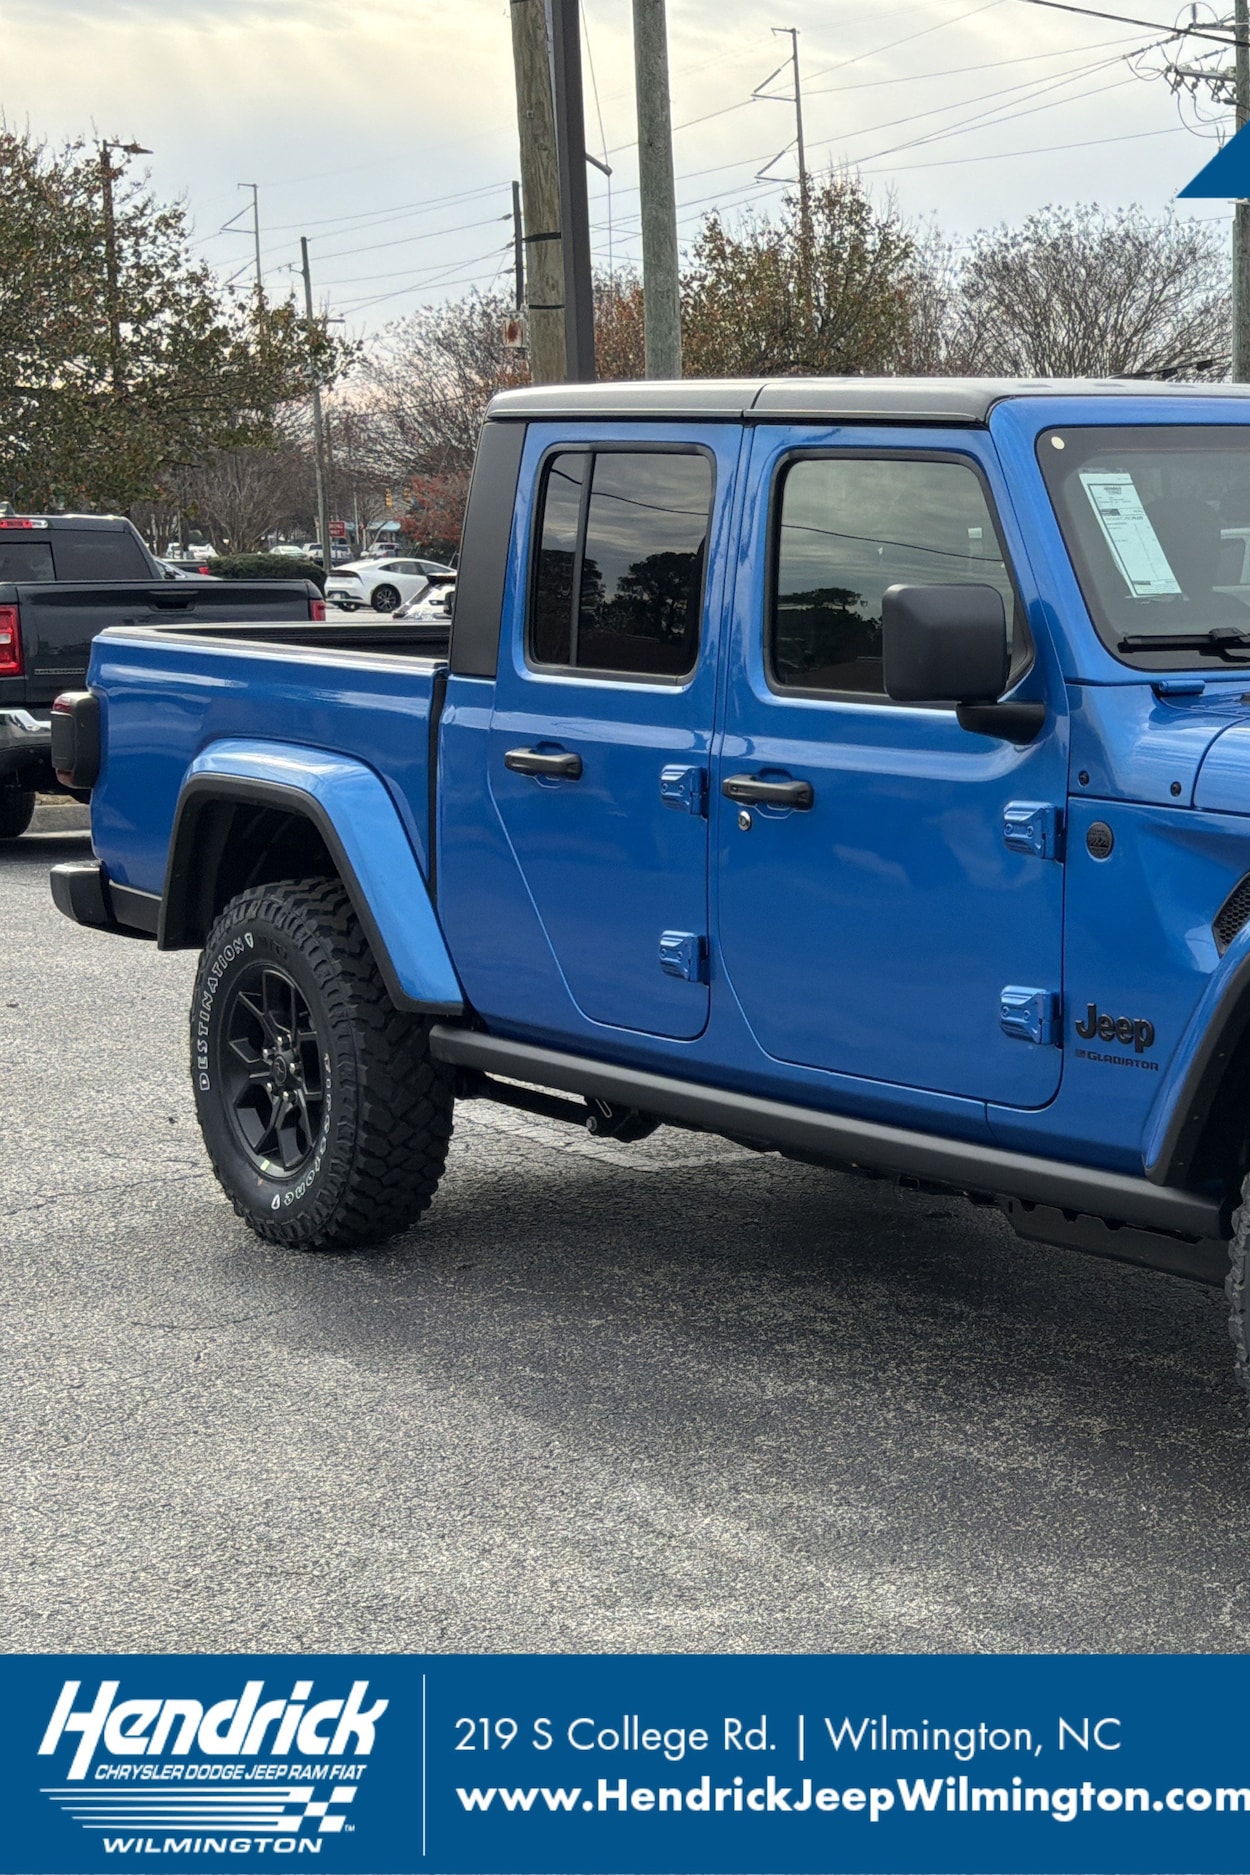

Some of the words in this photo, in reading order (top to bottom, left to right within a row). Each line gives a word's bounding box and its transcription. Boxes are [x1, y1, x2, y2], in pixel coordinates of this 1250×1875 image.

[200, 936, 246, 1092] DESTINATION
[1075, 1002, 1155, 1054] Jeep
[1087, 1050, 1160, 1072] GLADIATOR
